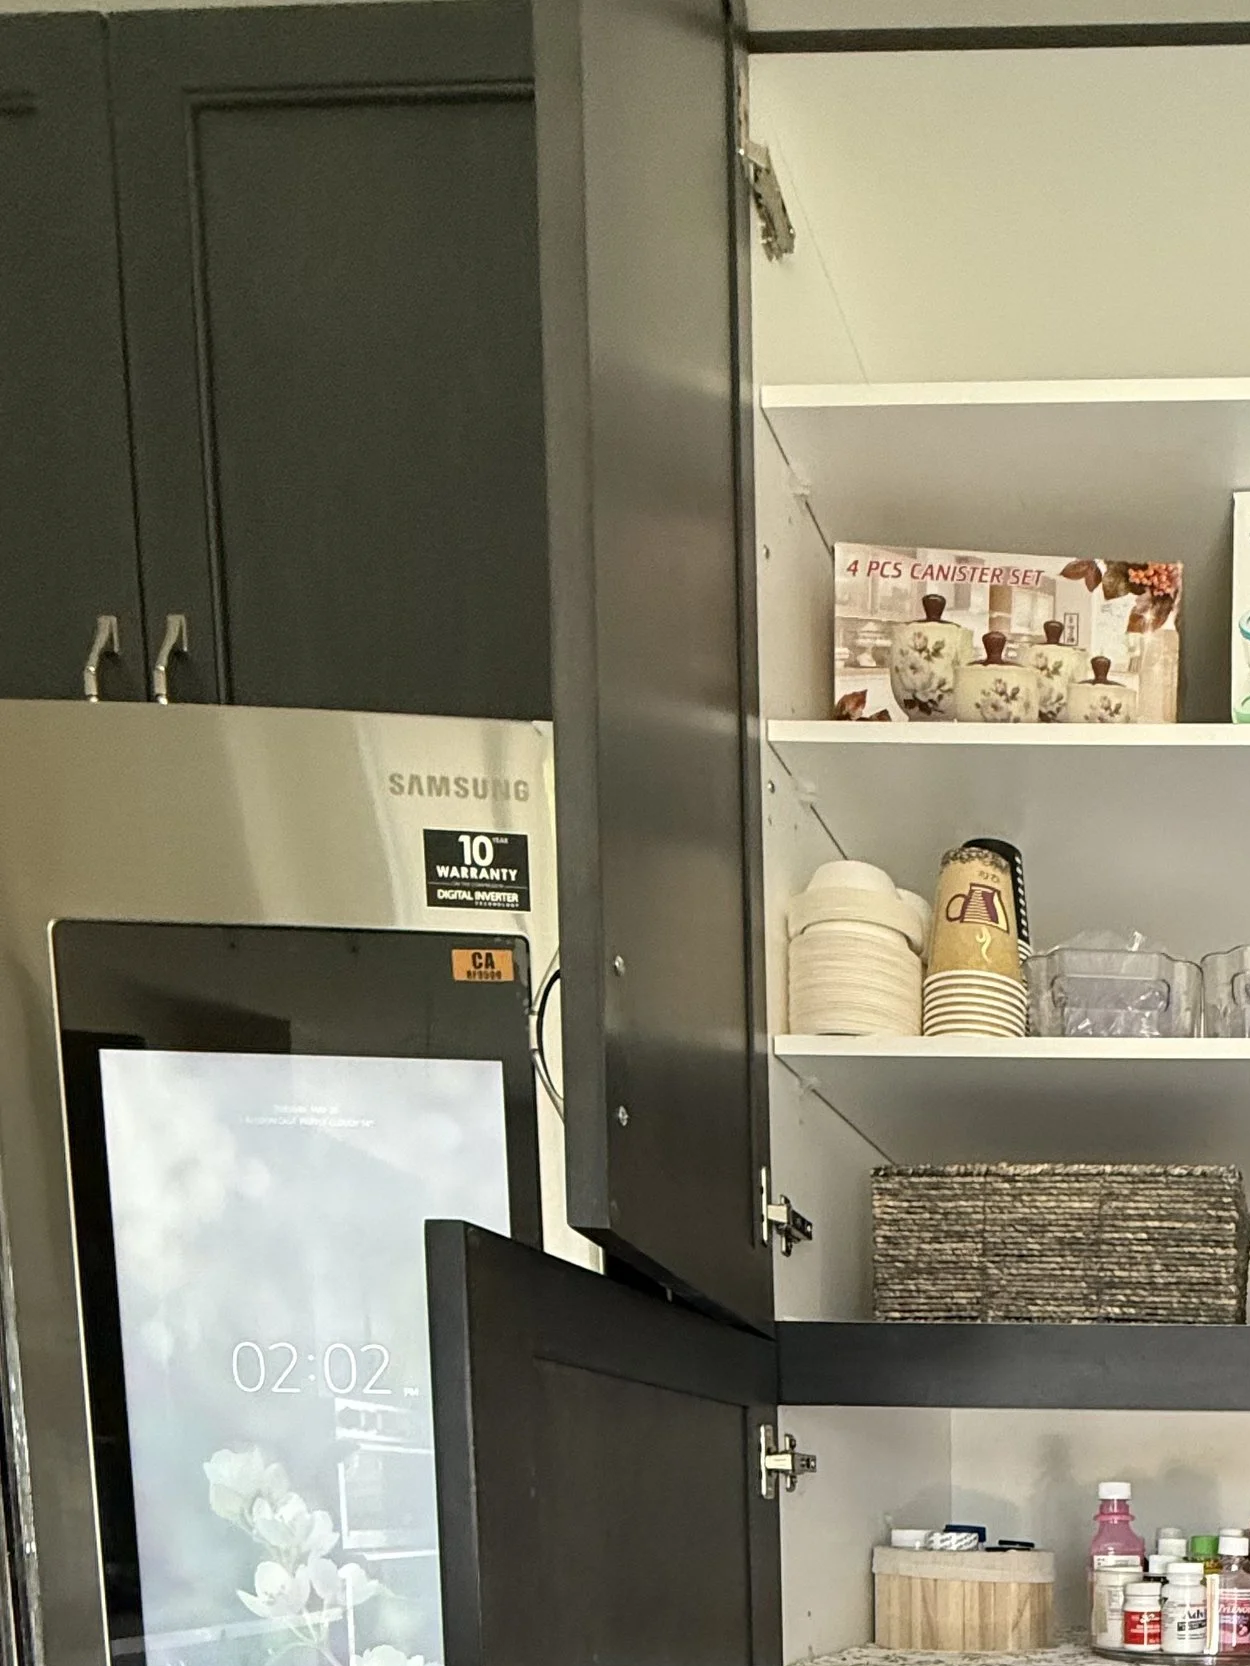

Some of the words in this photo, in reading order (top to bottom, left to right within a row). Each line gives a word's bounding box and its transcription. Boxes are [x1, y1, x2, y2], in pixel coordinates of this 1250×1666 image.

[846, 559, 859, 577] 4
[866, 560, 902, 579] PCS
[910, 562, 1001, 584] CANISTER
[1008, 568, 1045, 586] SET
[388, 773, 530, 802] SAMSUNG
[458, 834, 495, 867] 10
[436, 865, 518, 882] WARRANTY
[437, 888, 474, 901] DIGITAL
[474, 890, 519, 903] INVERTER
[471, 951, 496, 970] CA
[232, 1341, 393, 1395] 02:02
